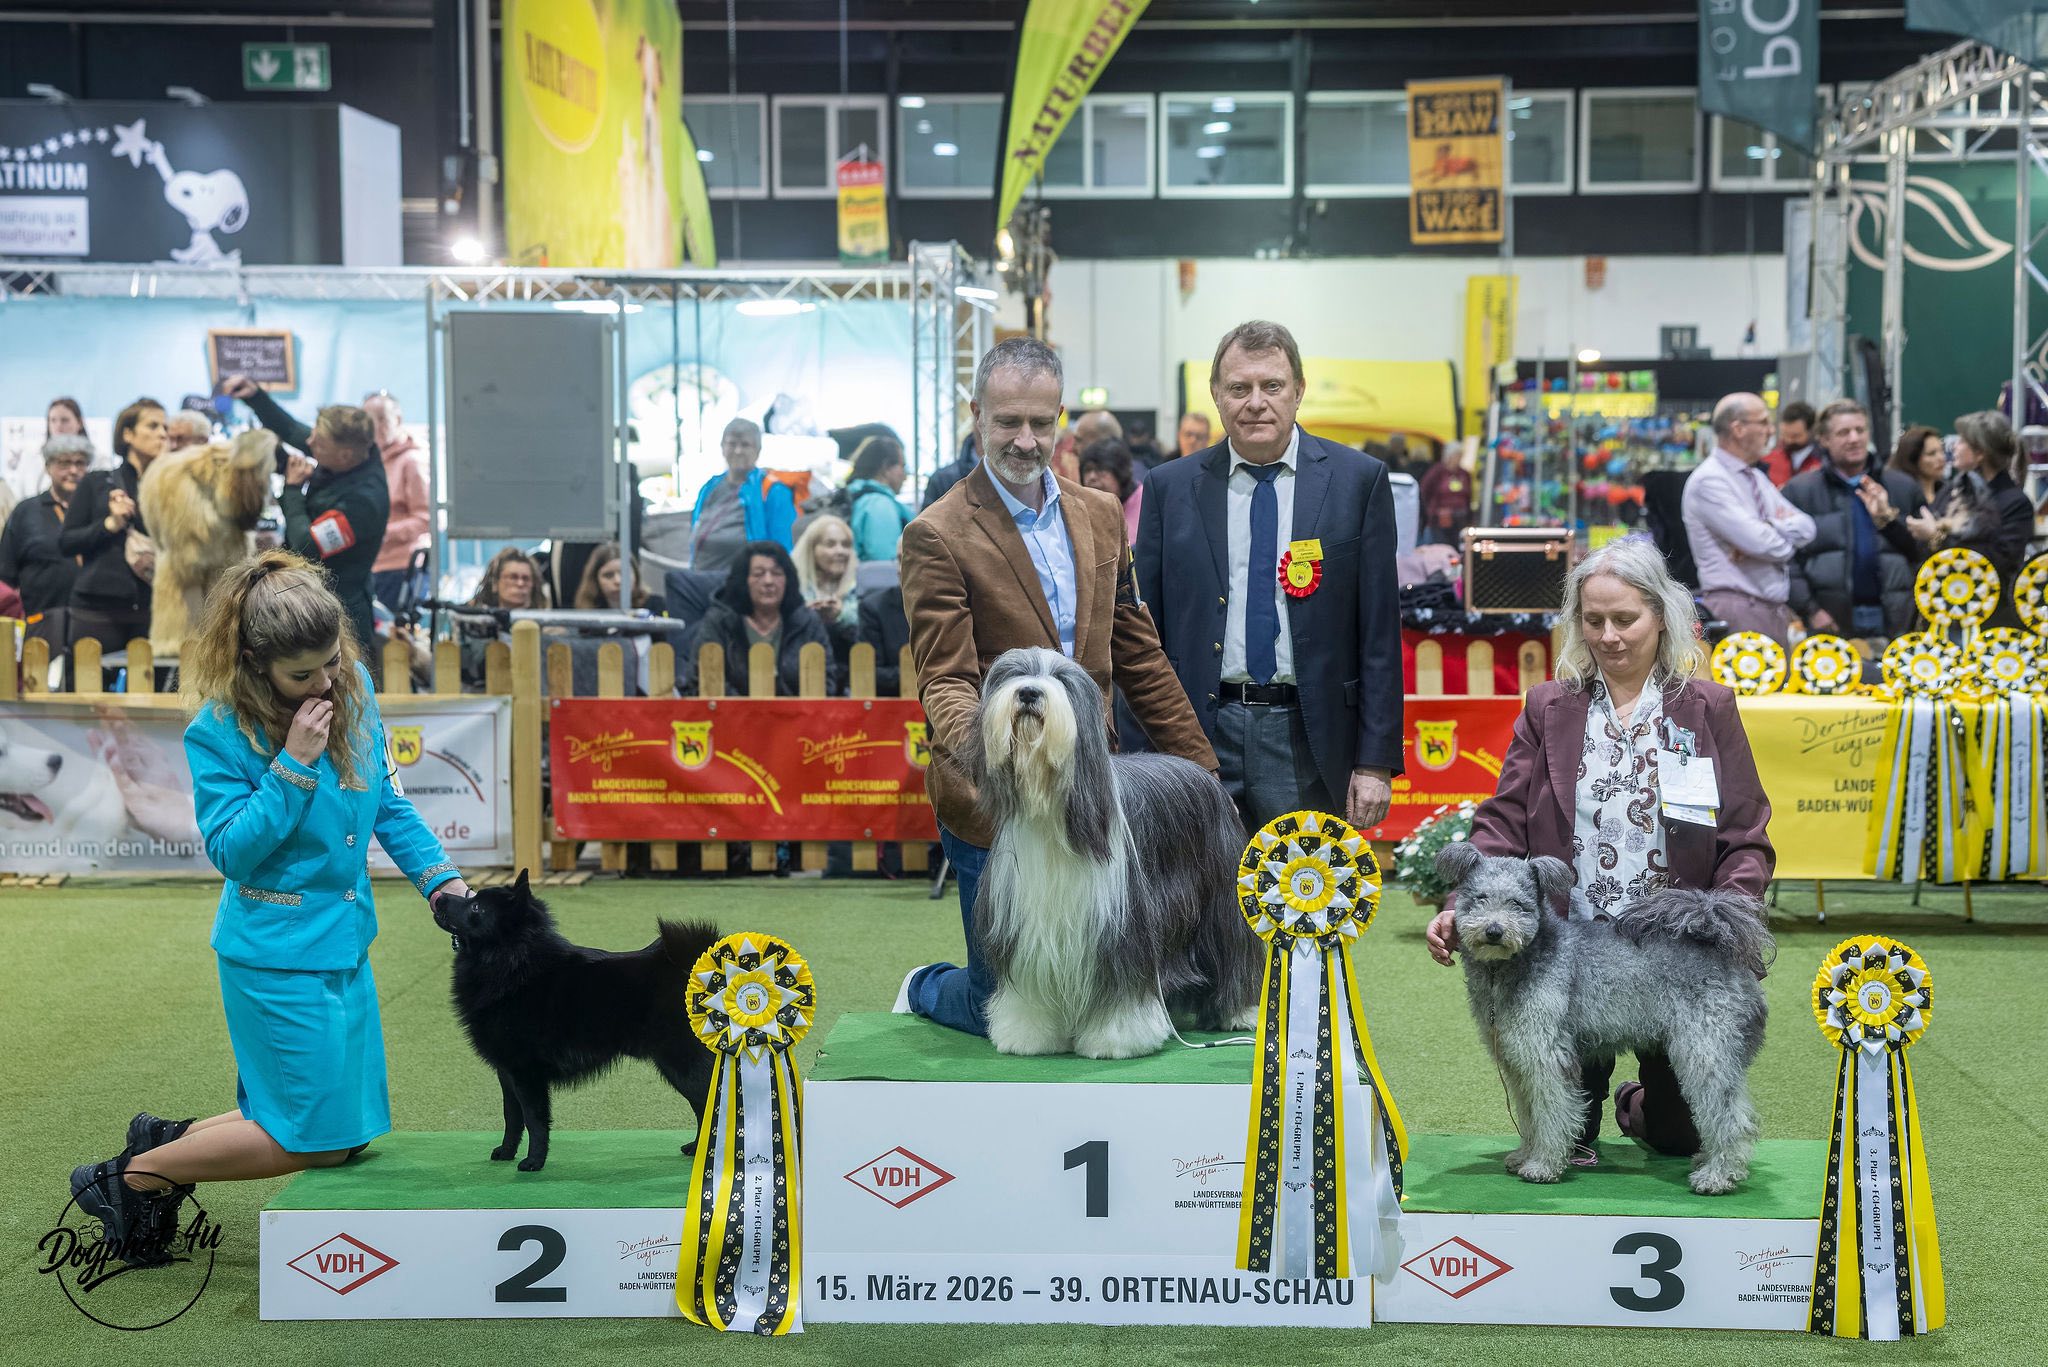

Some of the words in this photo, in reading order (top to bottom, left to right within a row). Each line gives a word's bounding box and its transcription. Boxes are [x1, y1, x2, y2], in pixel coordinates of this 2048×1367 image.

[0, 161, 88, 190] TINUM
[1793, 716, 1831, 744] Der
[11, 837, 61, 857] rund
[65, 842, 100, 857] um
[104, 836, 145, 857] den
[1295, 1082, 1305, 1104] Platz
[1292, 1111, 1303, 1162] FCI-GRUPPE
[1172, 1157, 1194, 1173] Der
[1194, 1152, 1225, 1167] Hunde
[1869, 1160, 1879, 1182] Platz
[872, 1166, 921, 1187] VDH
[1063, 1140, 1109, 1218] 1
[754, 1186, 763, 1208] Platz
[1871, 1190, 1883, 1245] FCI-GRUPPE
[616, 1240, 638, 1254] Der
[638, 1234, 669, 1248] Hunde
[752, 1215, 763, 1269] FCI-GRUPPE
[315, 1253, 365, 1274] VDH
[495, 1224, 568, 1303] 2
[1735, 1250, 1757, 1266] Der
[1758, 1244, 1790, 1258] Hunde
[1429, 1256, 1478, 1278] VDH
[1609, 1231, 1686, 1313] 3
[816, 1275, 856, 1301] 15.
[866, 1274, 938, 1301] März
[946, 1275, 1014, 1302] 2026
[1049, 1276, 1091, 1303] 39.
[1101, 1276, 1355, 1306] ORTENAU-SCHAU
[1738, 1293, 1812, 1303] BADEN-WÜRTTEMBER
